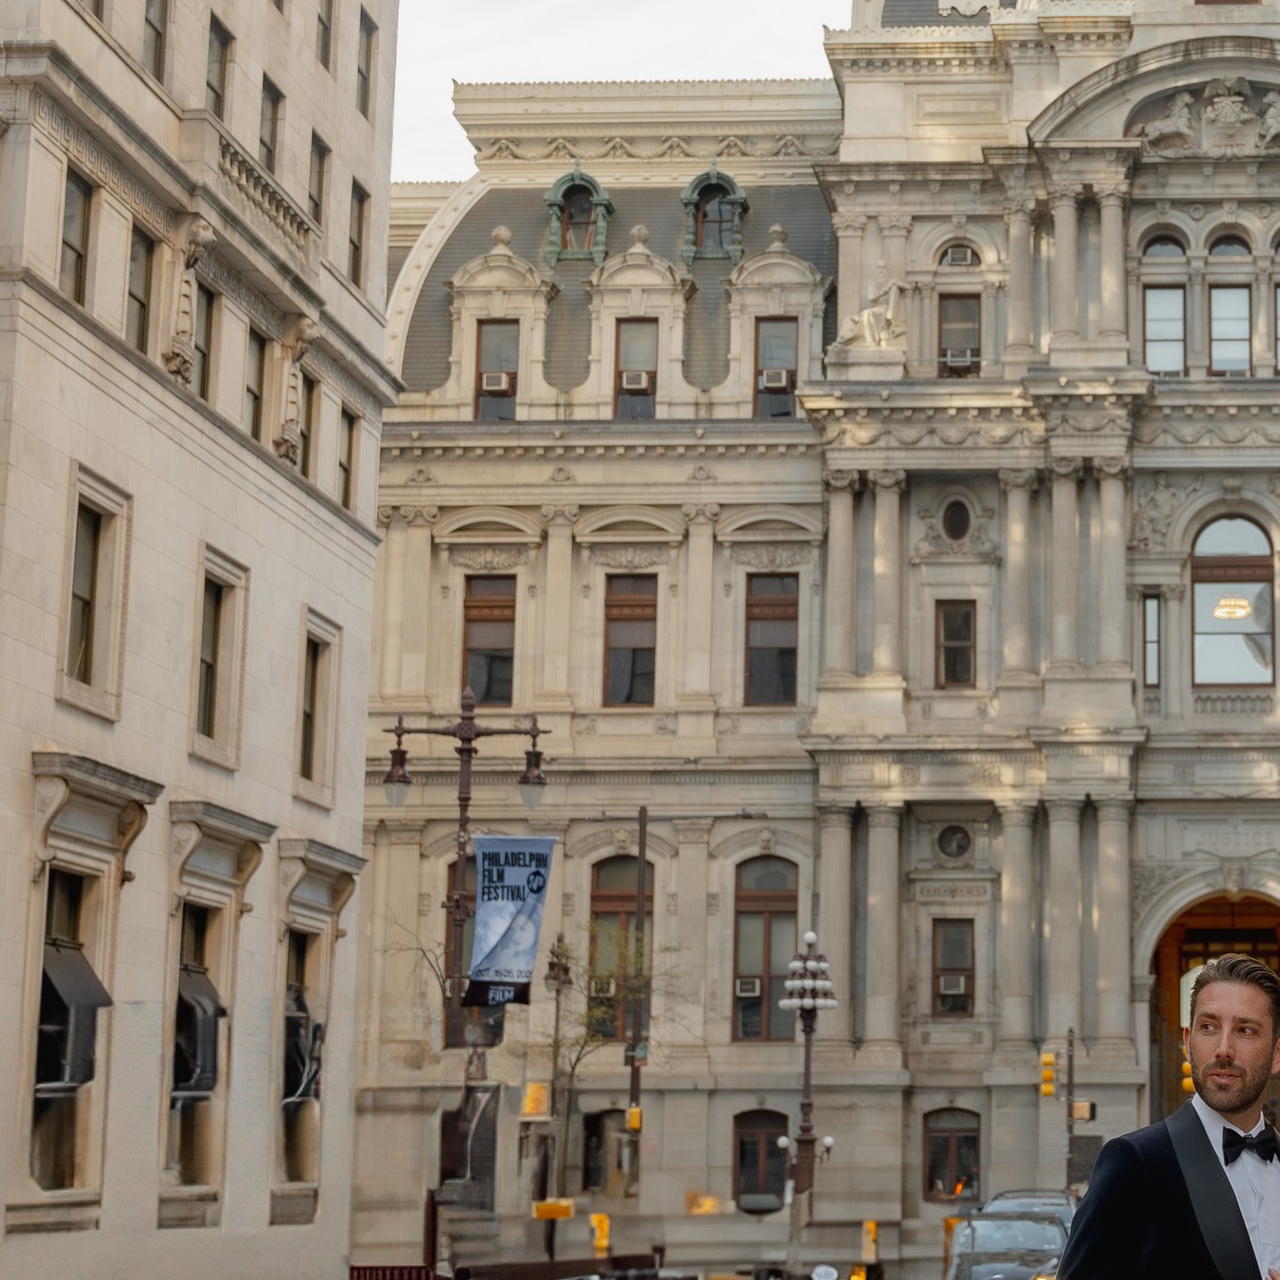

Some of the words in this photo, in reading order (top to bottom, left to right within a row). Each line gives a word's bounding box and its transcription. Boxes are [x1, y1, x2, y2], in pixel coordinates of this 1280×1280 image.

[1197, 831, 1275, 847] JUSTICE
[482, 868, 505, 885] FILM
[482, 885, 526, 901] FESTIVAL
[488, 988, 515, 1002] FILM
